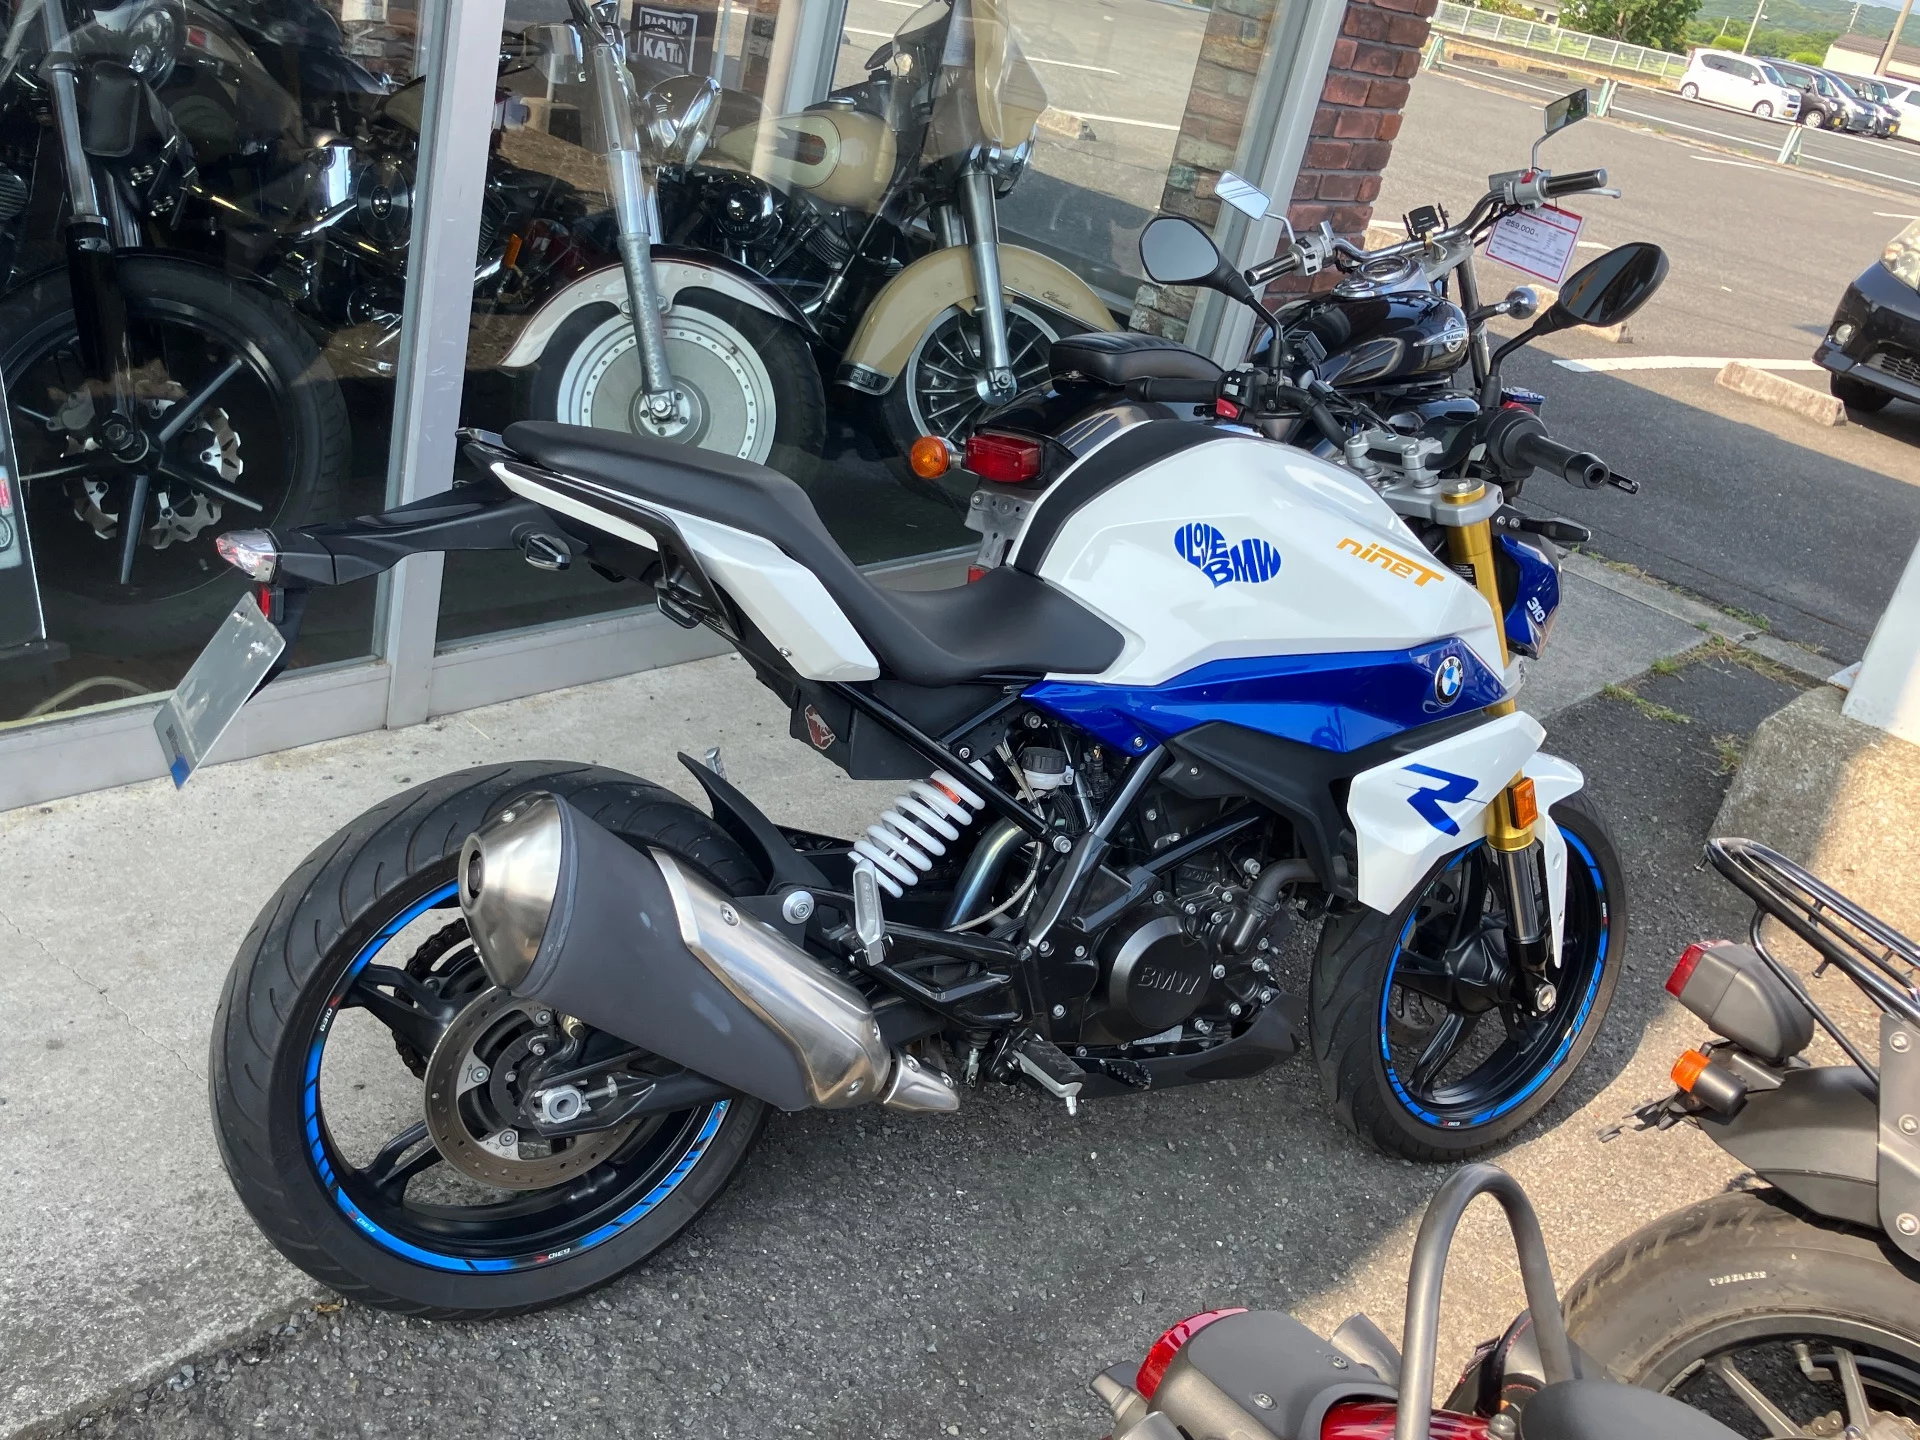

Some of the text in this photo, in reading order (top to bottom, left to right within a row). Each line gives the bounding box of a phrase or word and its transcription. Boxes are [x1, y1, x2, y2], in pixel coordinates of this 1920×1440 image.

[1201, 538, 1282, 589] BMW
[1526, 596, 1546, 623] 310
[1137, 965, 1202, 996] BMW
